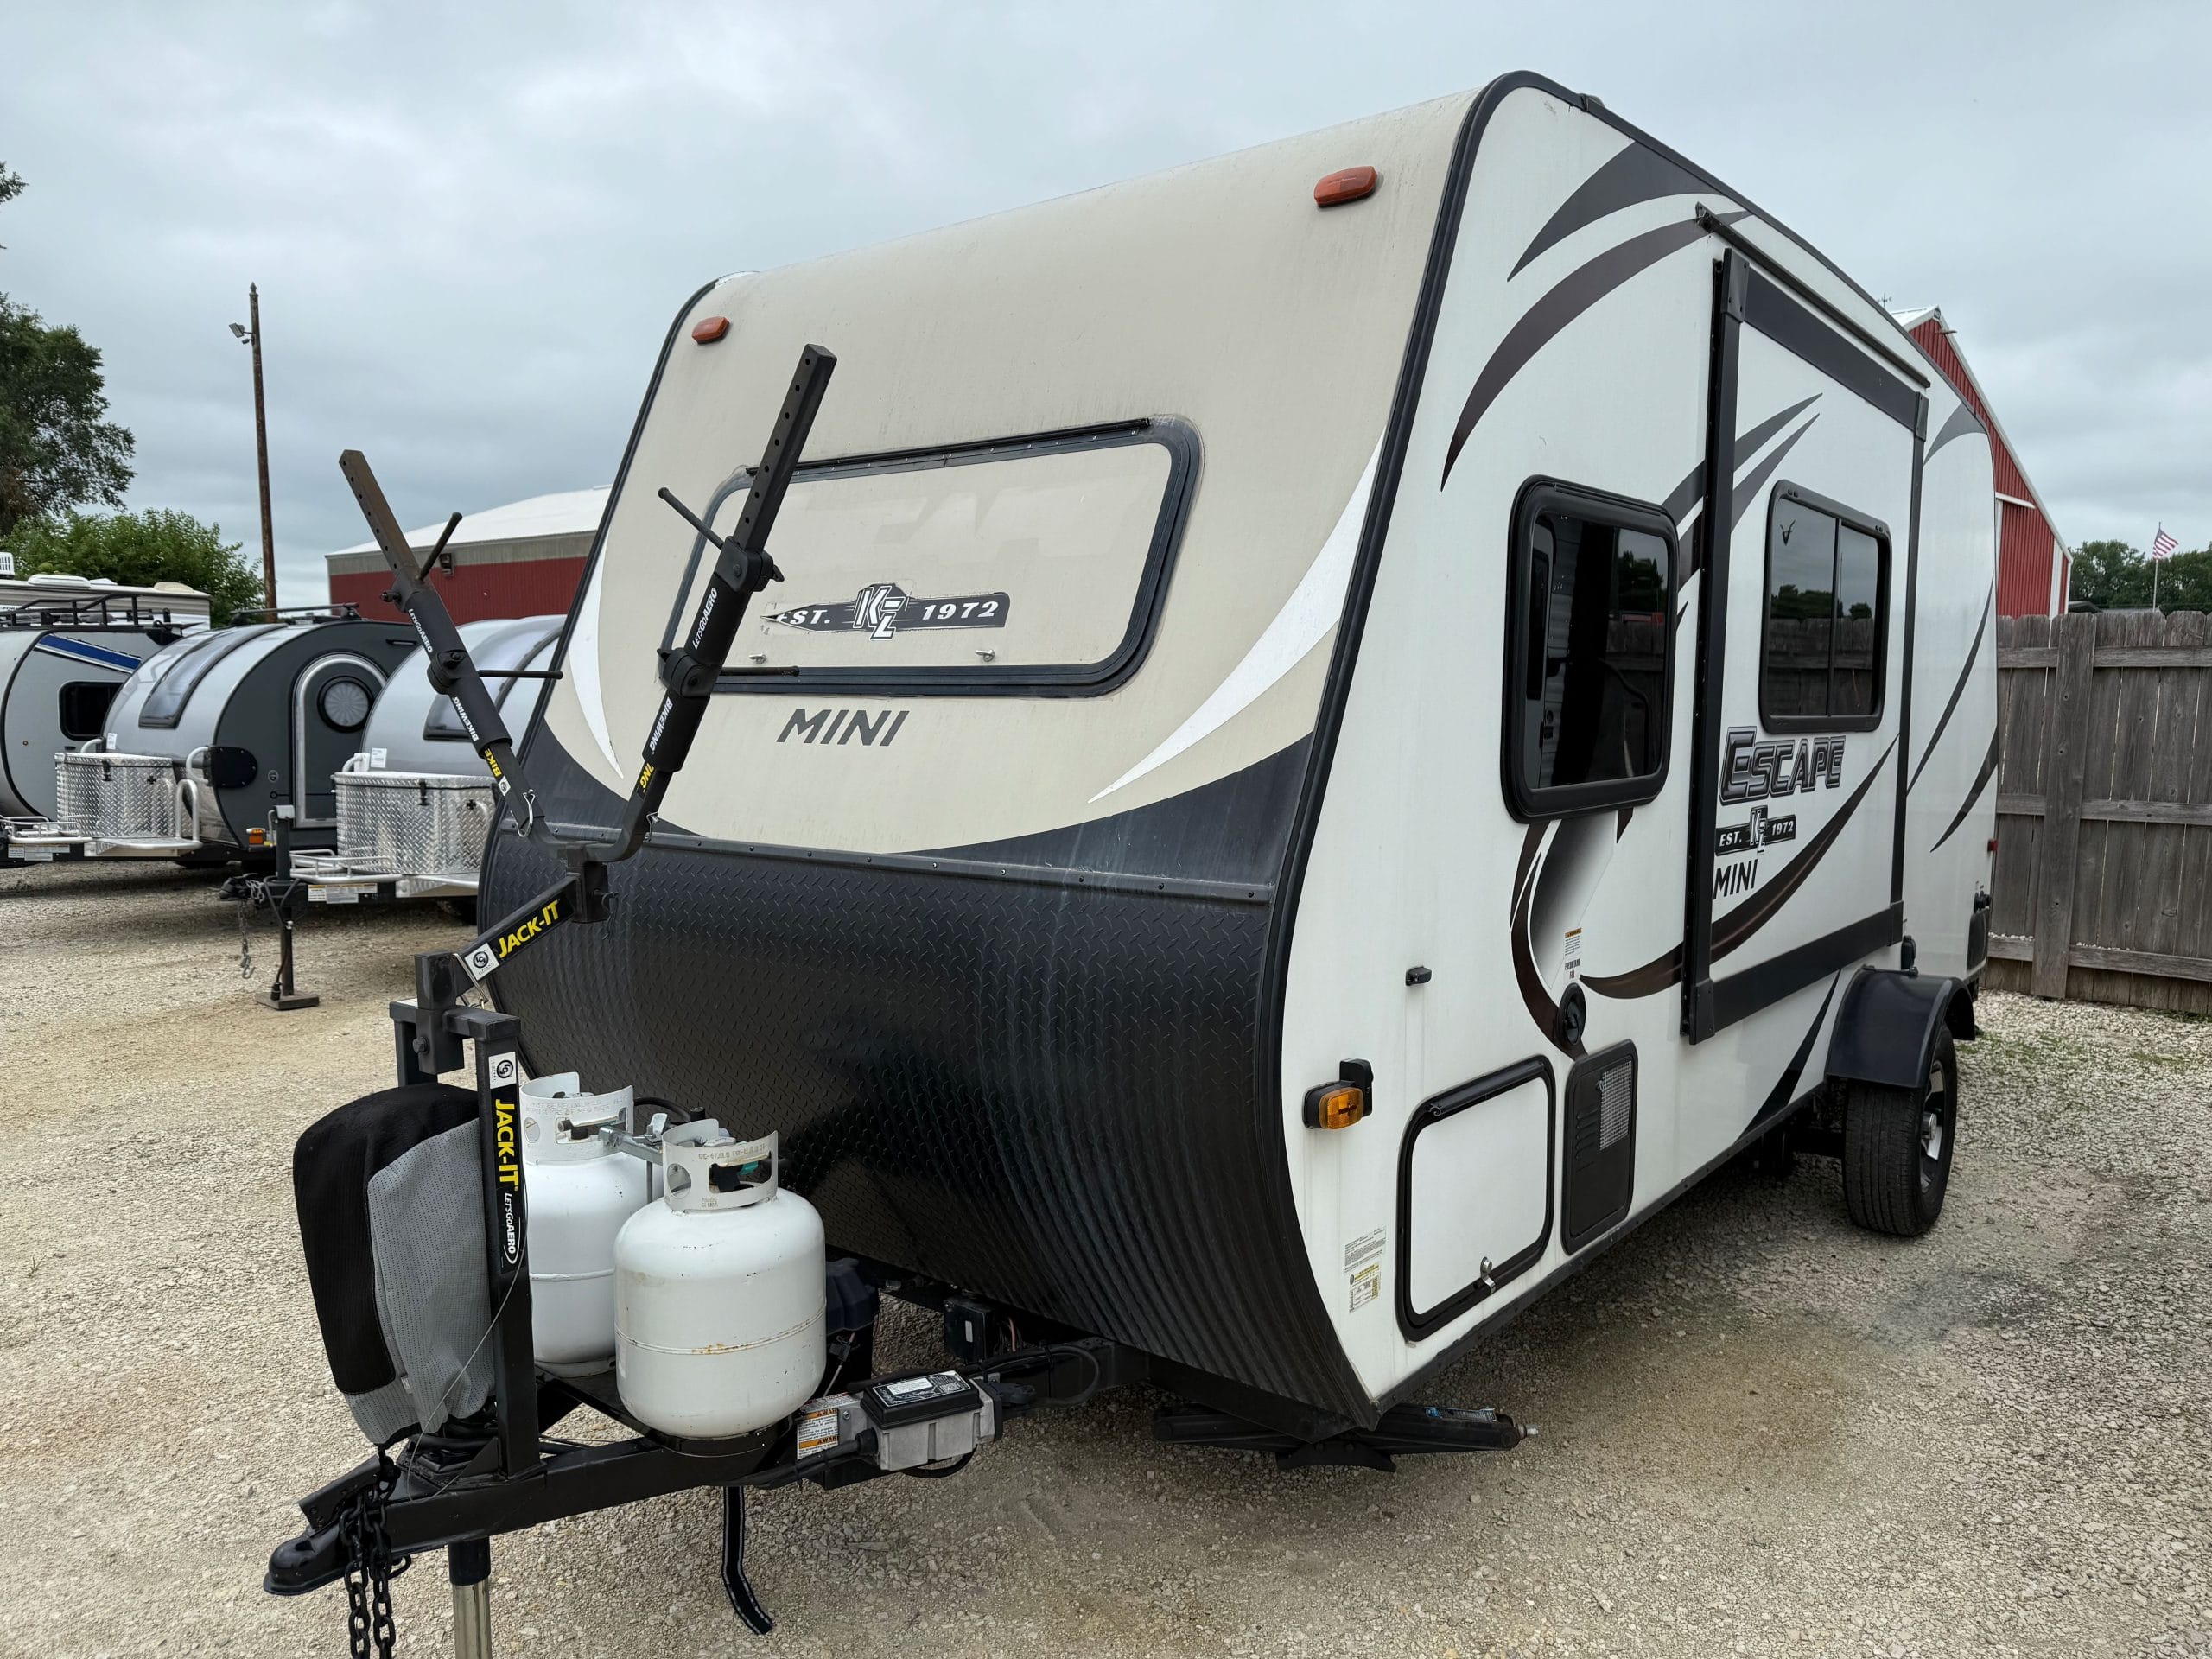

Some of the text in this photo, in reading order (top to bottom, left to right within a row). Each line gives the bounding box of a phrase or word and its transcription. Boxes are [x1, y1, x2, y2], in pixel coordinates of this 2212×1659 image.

[921, 601, 999, 620] 1972
[452, 696, 480, 741] BIKEWING
[650, 696, 673, 752] BIKEWING
[776, 709, 910, 747] MINI
[1719, 726, 1846, 806] ESCAPE
[1719, 831, 1742, 847] EST.
[1771, 821, 1794, 836] 1972
[1713, 859, 1758, 899] MINI
[499, 899, 559, 958] JACK-IT
[495, 1098, 518, 1190] JACK-IT
